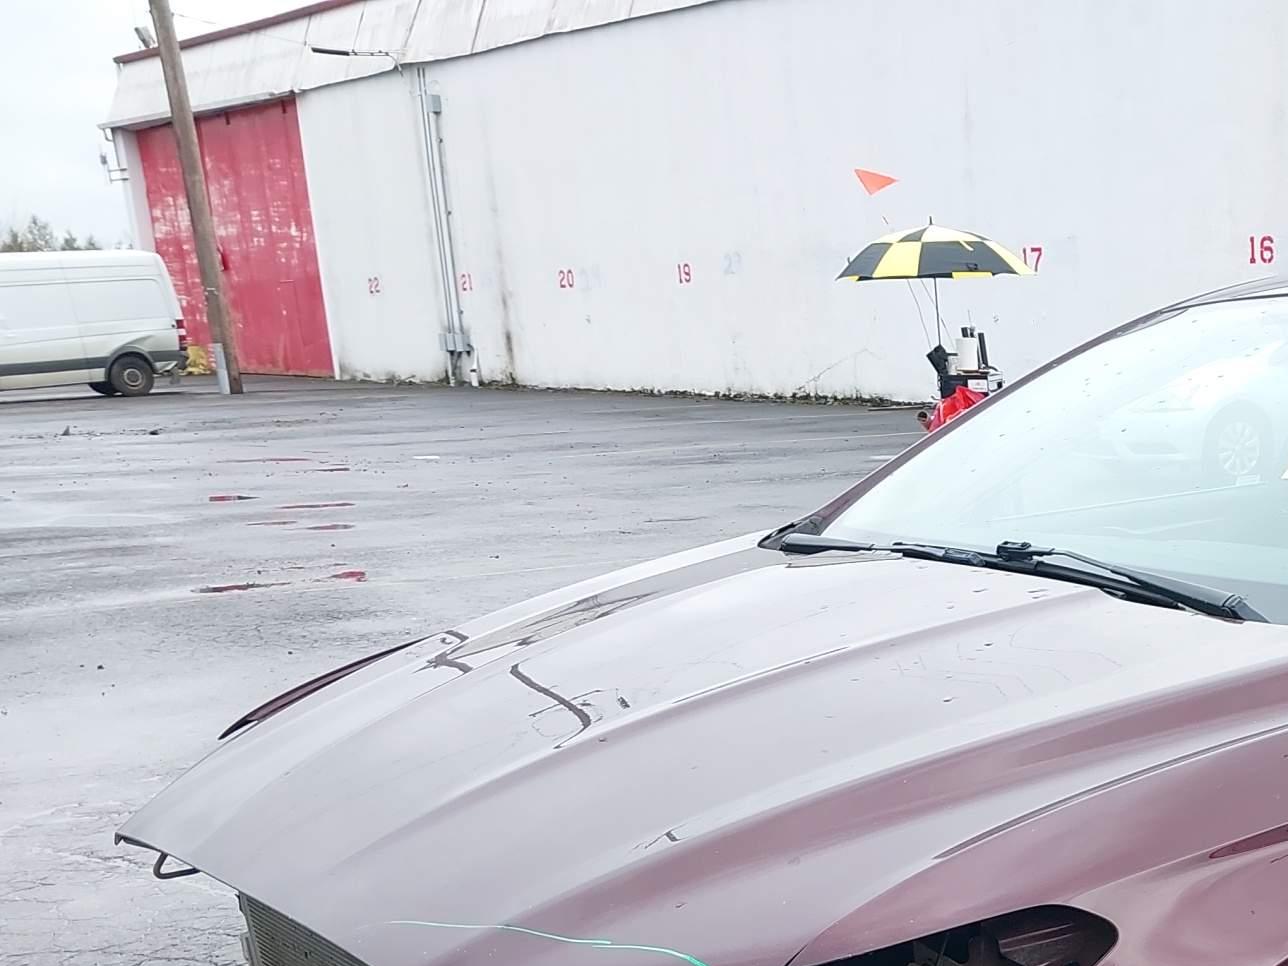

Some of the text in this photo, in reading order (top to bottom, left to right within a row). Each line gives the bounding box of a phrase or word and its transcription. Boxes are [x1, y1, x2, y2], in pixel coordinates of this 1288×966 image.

[1022, 246, 1043, 273] 17
[1249, 235, 1274, 264] 16
[460, 273, 473, 292] 21
[558, 269, 574, 288] 20
[677, 263, 691, 284] 19
[368, 276, 380, 294] 22
